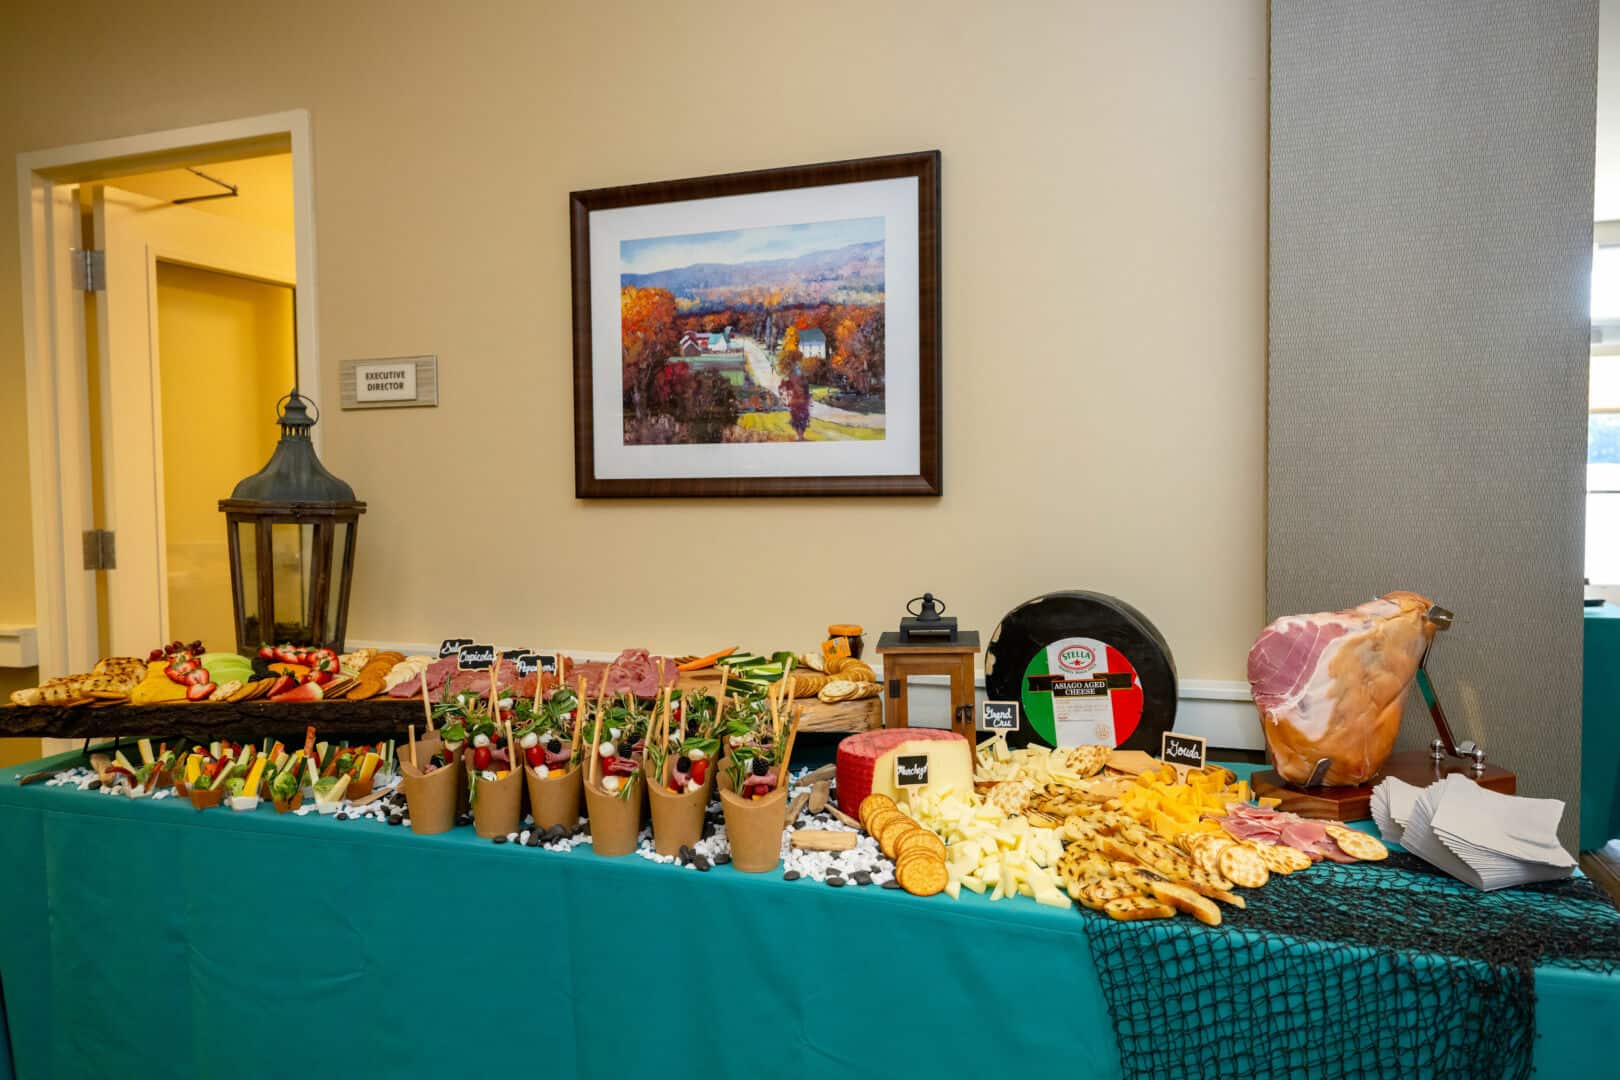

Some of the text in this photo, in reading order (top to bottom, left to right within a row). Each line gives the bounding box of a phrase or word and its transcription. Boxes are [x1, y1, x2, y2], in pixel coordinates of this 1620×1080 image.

[365, 371, 405, 380] EXECUTIVE
[367, 382, 405, 391] DIRECTOR
[459, 650, 493, 664] Capicola
[1062, 650, 1091, 660] STELLA
[1065, 688, 1096, 696] CHEESE
[1166, 740, 1200, 759] Gouda
